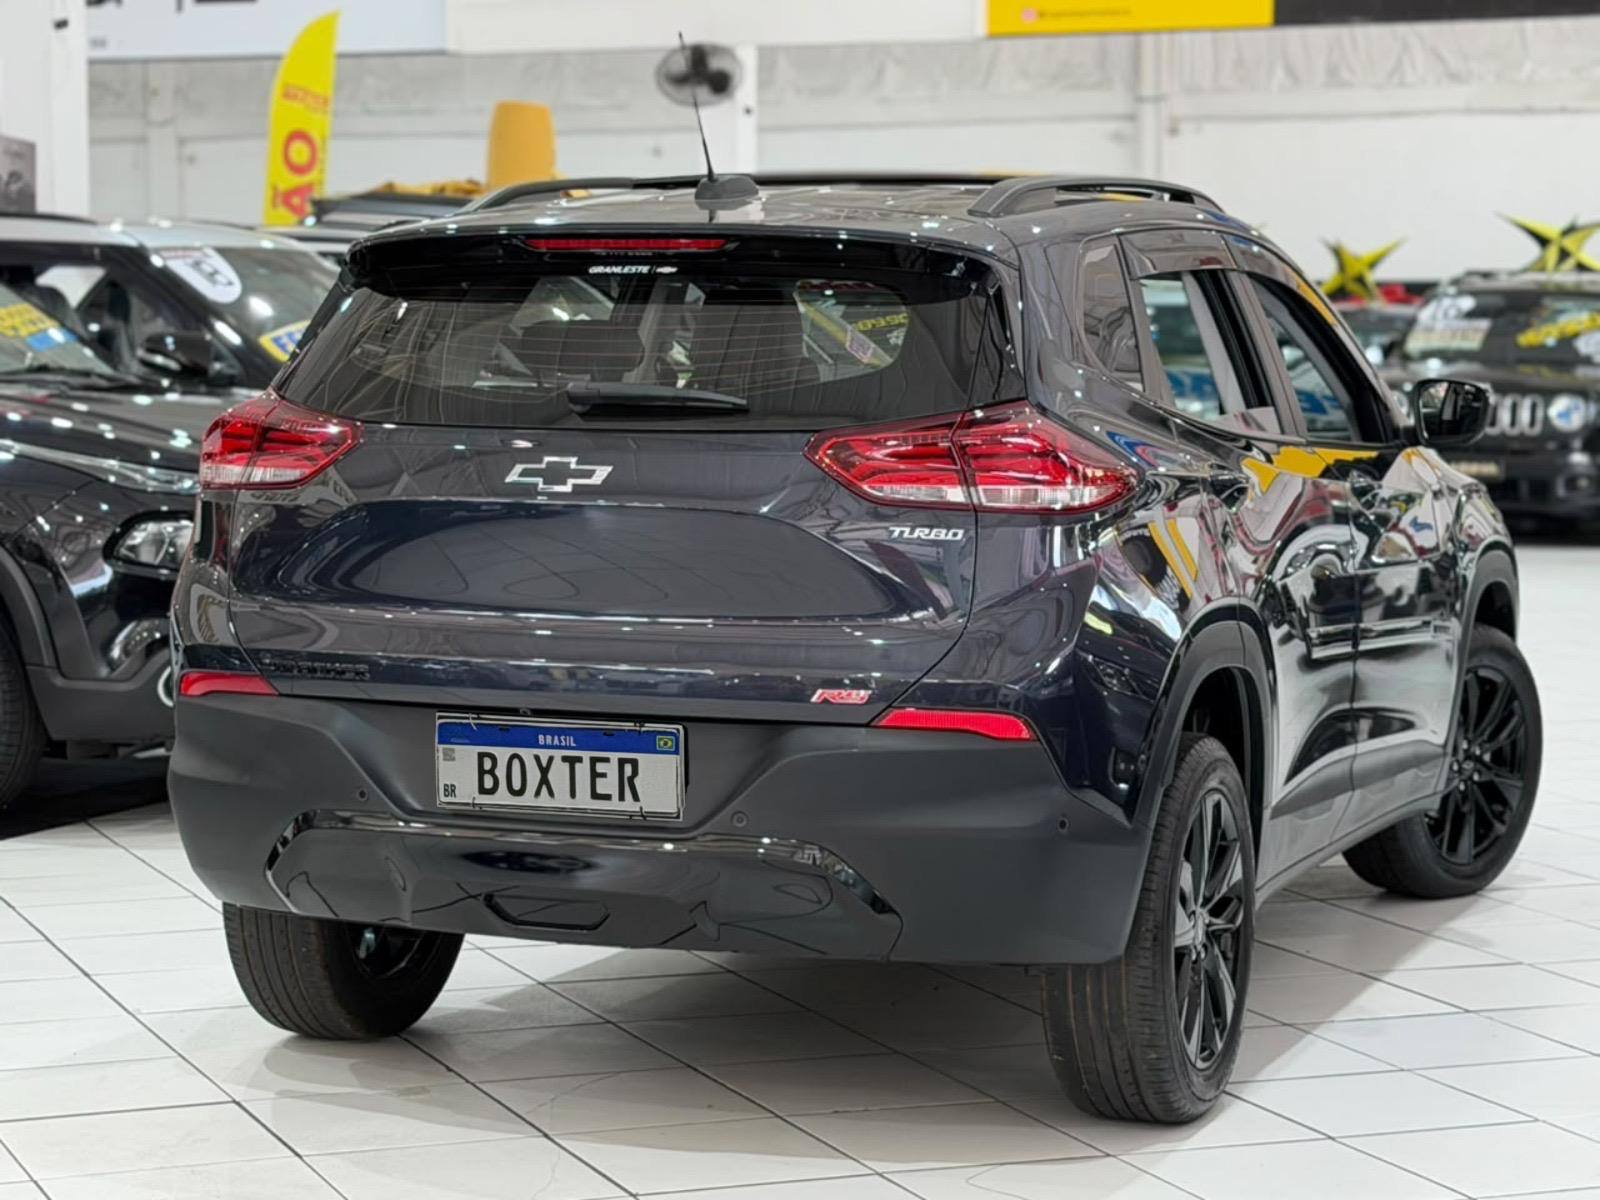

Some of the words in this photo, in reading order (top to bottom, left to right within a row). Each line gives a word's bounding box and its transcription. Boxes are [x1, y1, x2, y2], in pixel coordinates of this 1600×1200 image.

[888, 526, 965, 541] TURBO
[537, 733, 577, 747] BRASIL
[476, 751, 641, 803] BOXTER
[442, 782, 457, 799] BR
